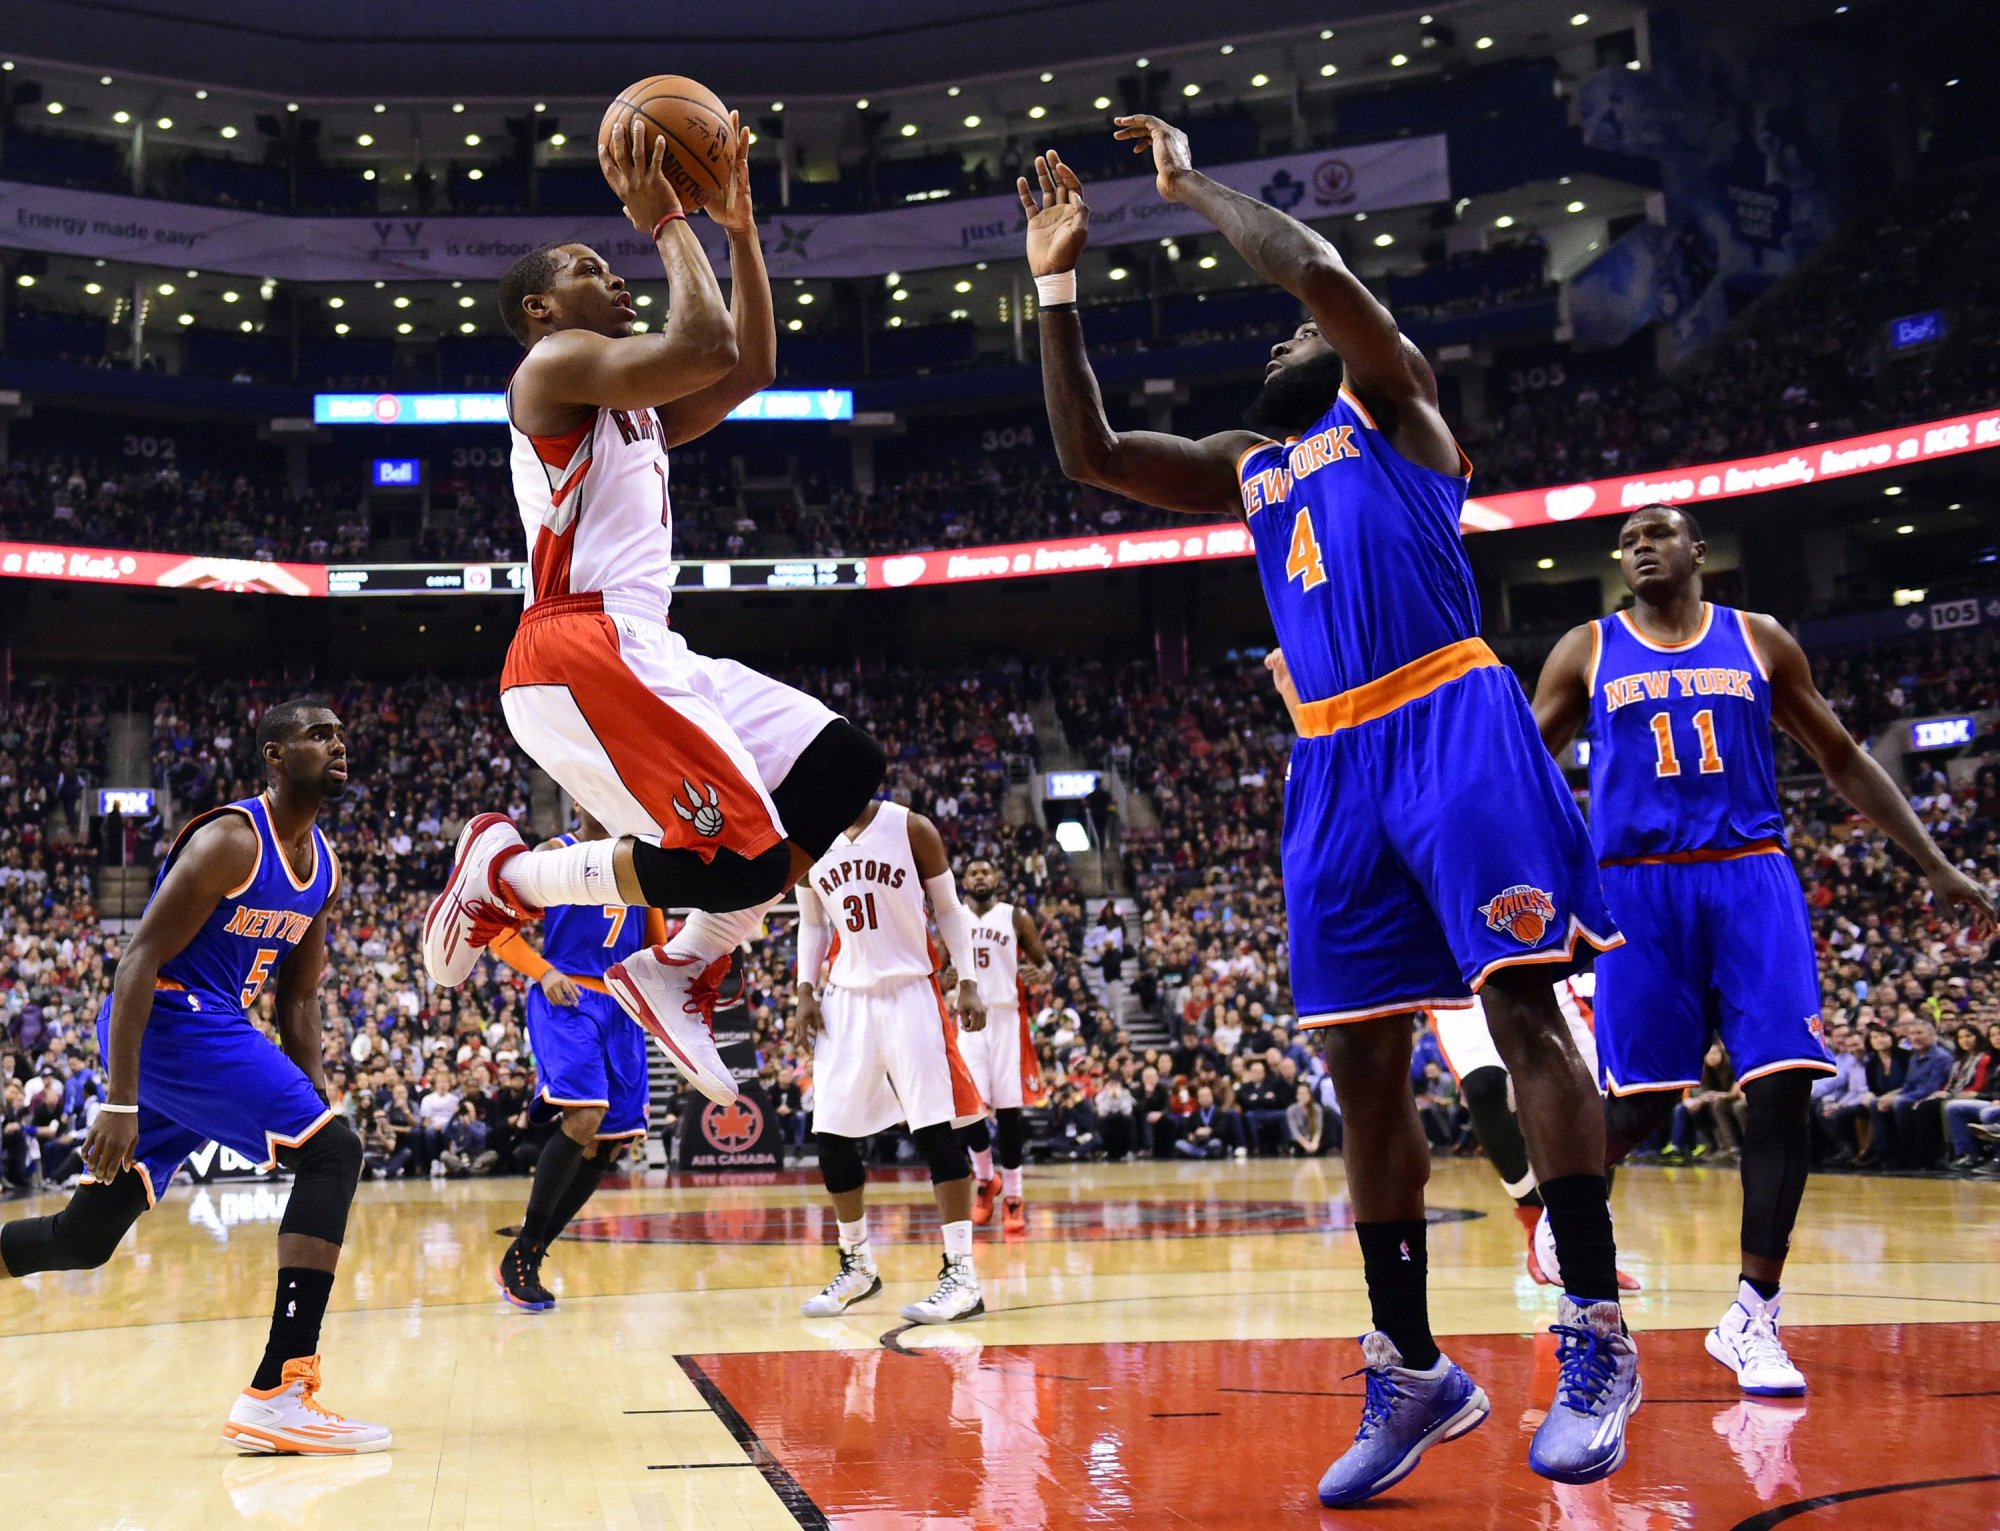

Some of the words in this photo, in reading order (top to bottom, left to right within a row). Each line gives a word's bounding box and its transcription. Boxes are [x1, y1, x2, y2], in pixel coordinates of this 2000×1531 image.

[17, 208, 88, 236] Energy
[93, 219, 148, 240] made
[122, 435, 176, 459] 302
[379, 462, 413, 482] Bell
[1621, 480, 1694, 506] Have
[1698, 476, 1720, 495] a
[1725, 457, 1814, 492] break,
[1820, 444, 1891, 474] have
[1897, 439, 1919, 459] a
[3, 554, 22, 572] a
[947, 556, 1009, 579] Have
[1013, 554, 1031, 572] a
[1035, 543, 1113, 570] break,
[1118, 540, 1180, 562] have
[1183, 537, 1203, 556] a
[1285, 505, 1328, 593] 4
[1934, 603, 1975, 625] 105
[1604, 670, 1671, 713] NEW
[1672, 667, 1755, 702] YORK
[1650, 709, 1724, 778] 11
[1915, 719, 1971, 747] IBM
[818, 858, 906, 897] RAPTORS
[224, 905, 283, 939] NEW
[603, 904, 628, 948] 7
[843, 892, 879, 933] 31
[1488, 888, 1555, 926] KNICKS
[971, 927, 1010, 948] PTORS
[240, 948, 278, 1009] 5
[691, 1154, 717, 1167] AIR
[718, 1152, 777, 1166] CANADA
